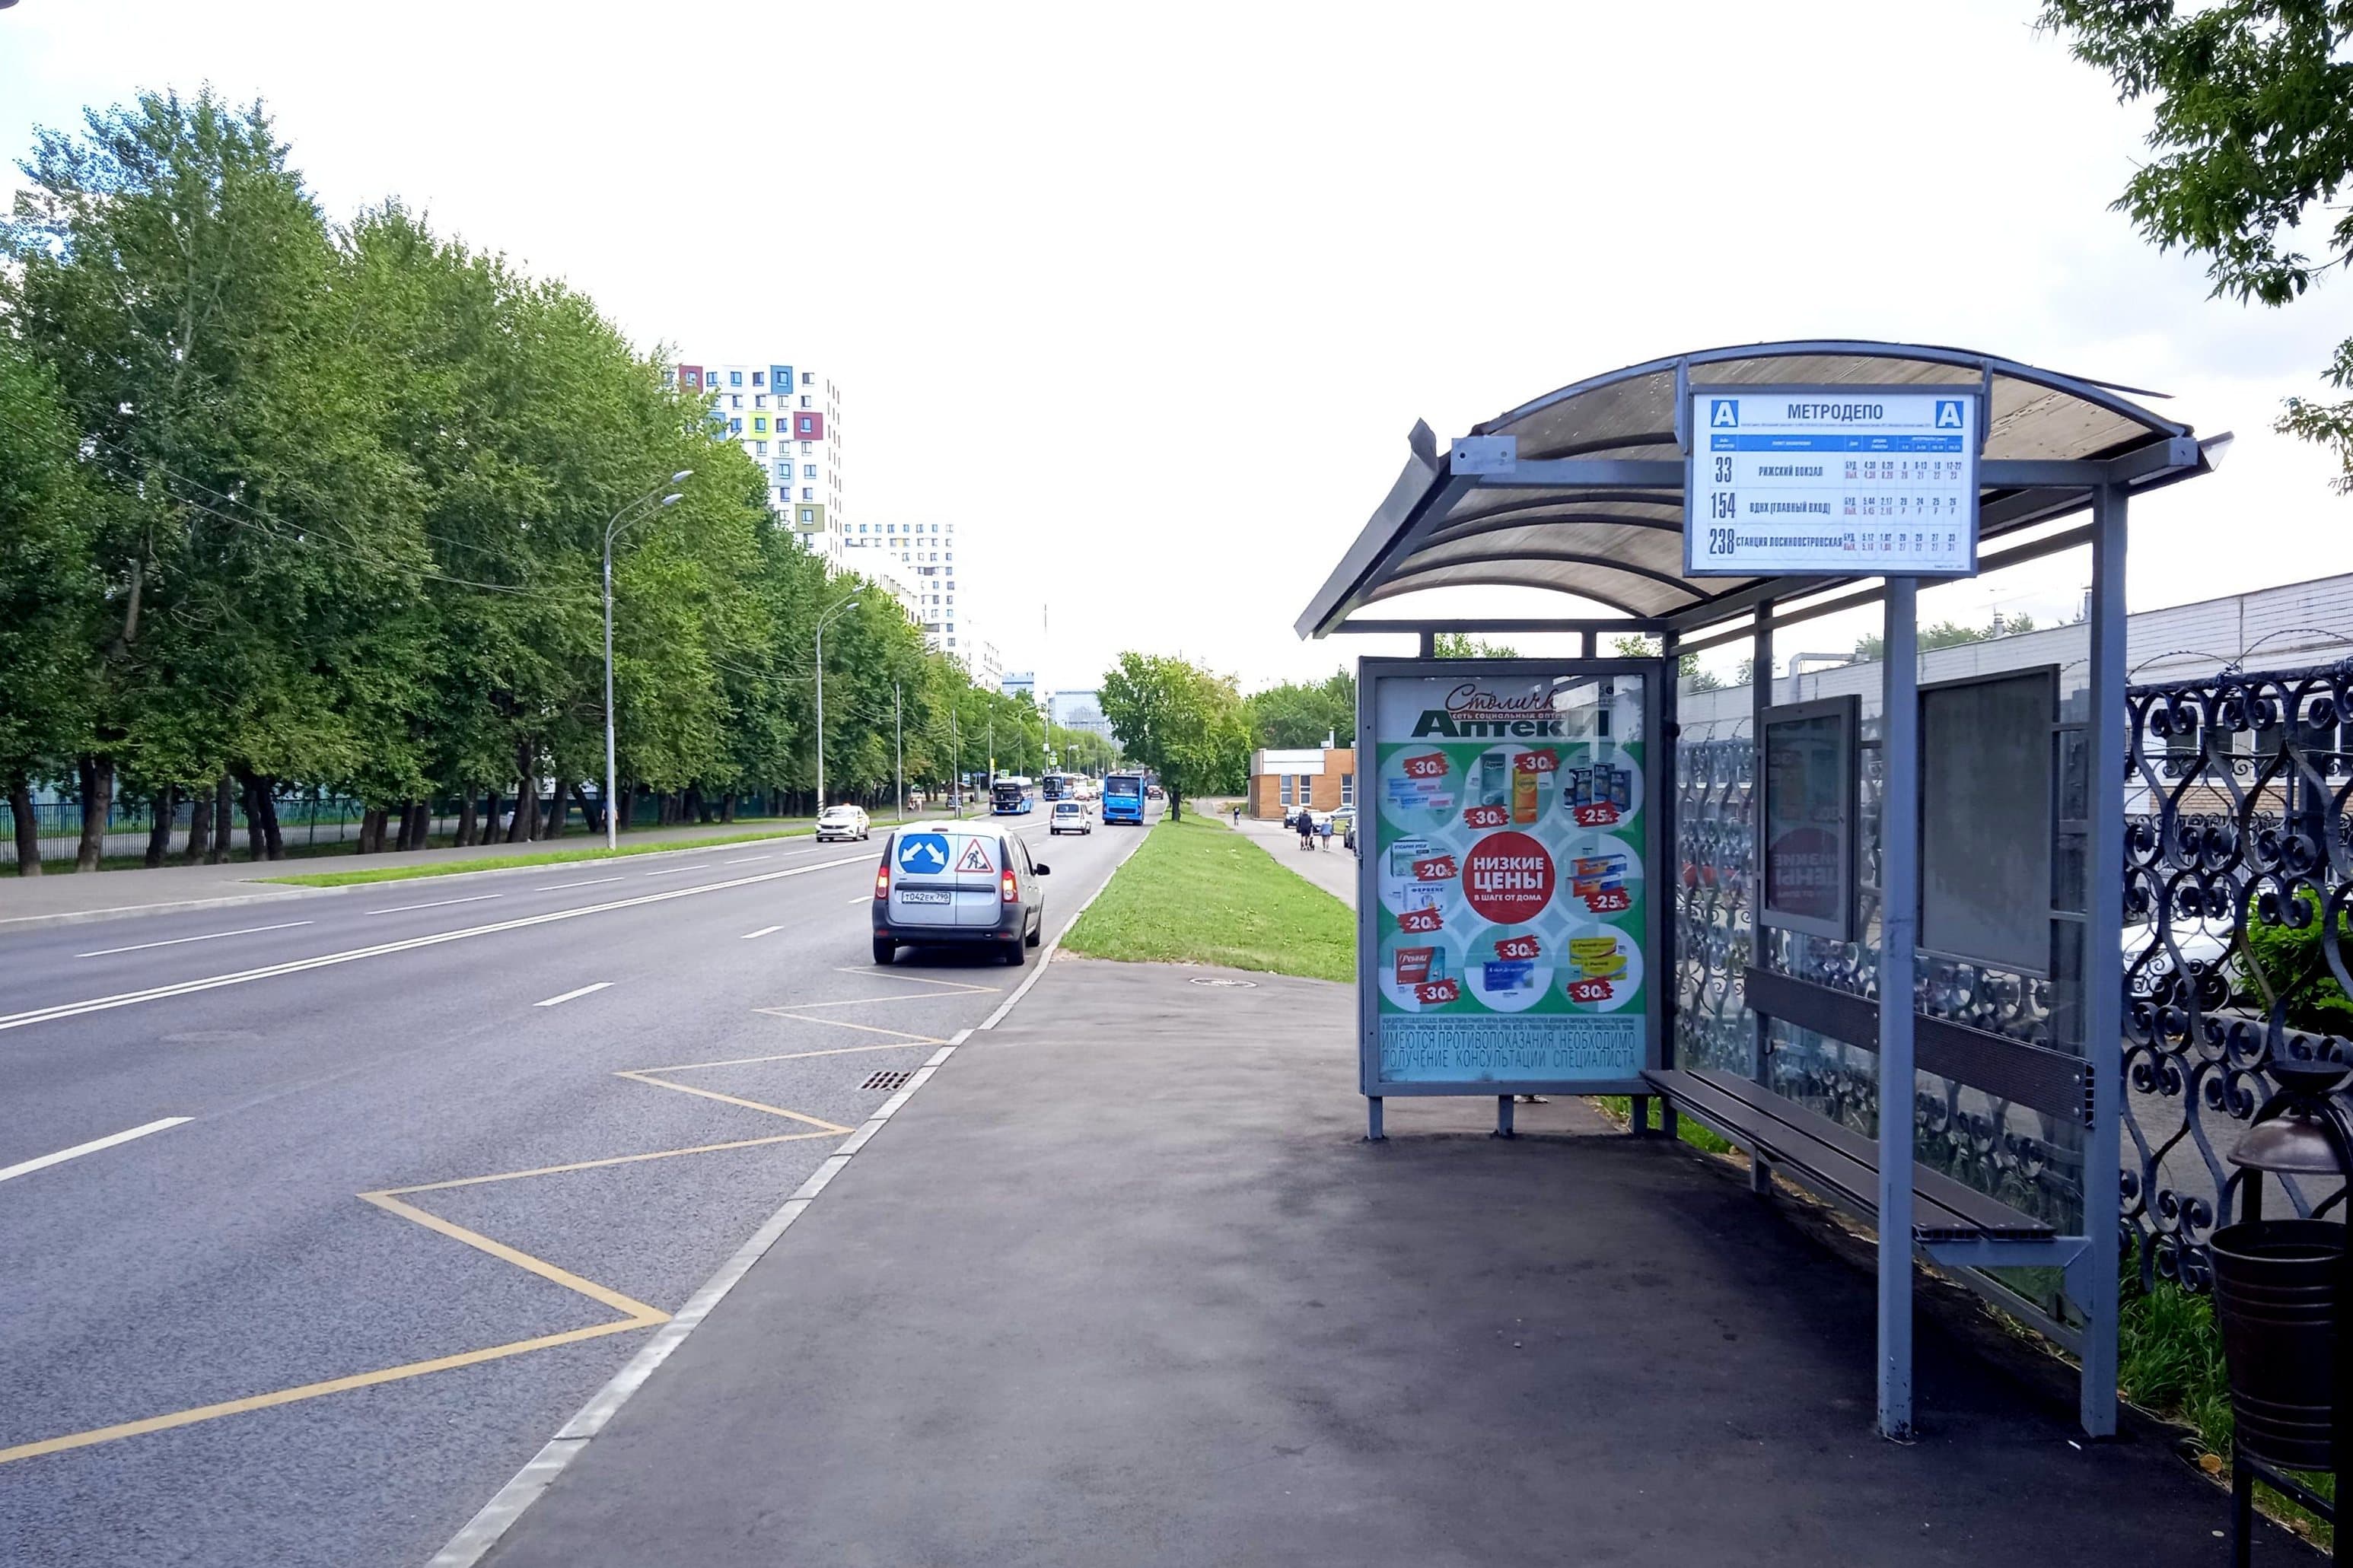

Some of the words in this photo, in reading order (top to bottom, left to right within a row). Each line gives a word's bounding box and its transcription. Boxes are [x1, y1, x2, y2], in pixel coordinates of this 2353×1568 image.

[1788, 404, 1883, 421] МЕТРОДЕПО
[1715, 456, 1732, 483] 33
[1759, 465, 1793, 476] РИЖСКИЙ
[1795, 466, 1823, 476] ВОКЗАЛ
[1711, 491, 1736, 519] 154
[1750, 502, 1769, 514] ВДНХ
[1770, 501, 1807, 514] (ГЛАВНЫЙ
[1809, 503, 1830, 514] ВХОД)
[1709, 528, 1735, 555] 238
[1736, 536, 1768, 548] СТАНЦИЯ
[1473, 857, 1543, 870] НИЗКИЕ
[1474, 872, 1543, 892] ЦЕНЫ
[1381, 1032, 1435, 1049] ИМЕЮТСЯ
[1560, 1032, 1635, 1051] НЕОБХОДИМО
[1382, 1050, 1449, 1067] ПОЛУЧЕНИЕ
[1456, 1050, 1546, 1069] КОНСУЛЬТАЦИИ
[1553, 1050, 1635, 1068] СПЕЦИАЛИСТА
